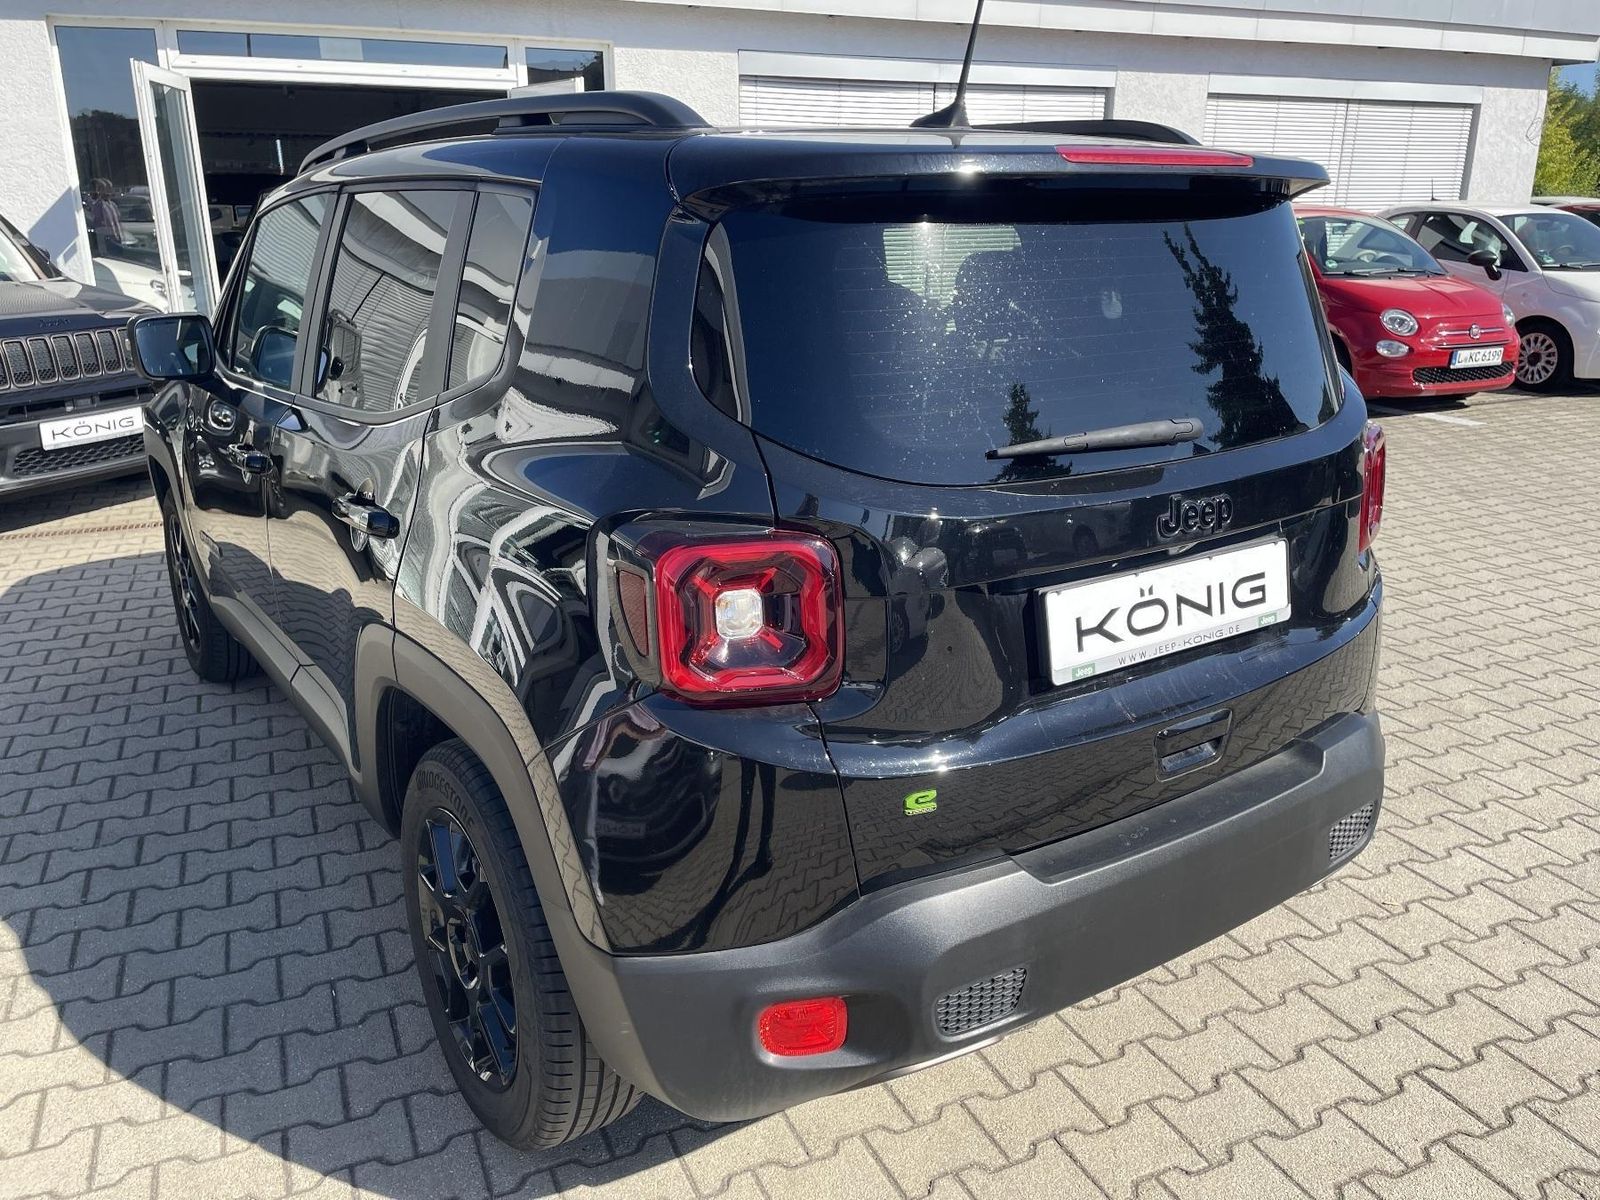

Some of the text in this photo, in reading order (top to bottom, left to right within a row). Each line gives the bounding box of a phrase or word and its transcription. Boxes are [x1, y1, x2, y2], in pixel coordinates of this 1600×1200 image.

[1468, 351, 1481, 363] KC
[1481, 349, 1502, 362] 6199
[51, 416, 135, 441] KÖNIG
[1156, 493, 1234, 539] Jeep
[1075, 571, 1267, 653] KÖNIG
